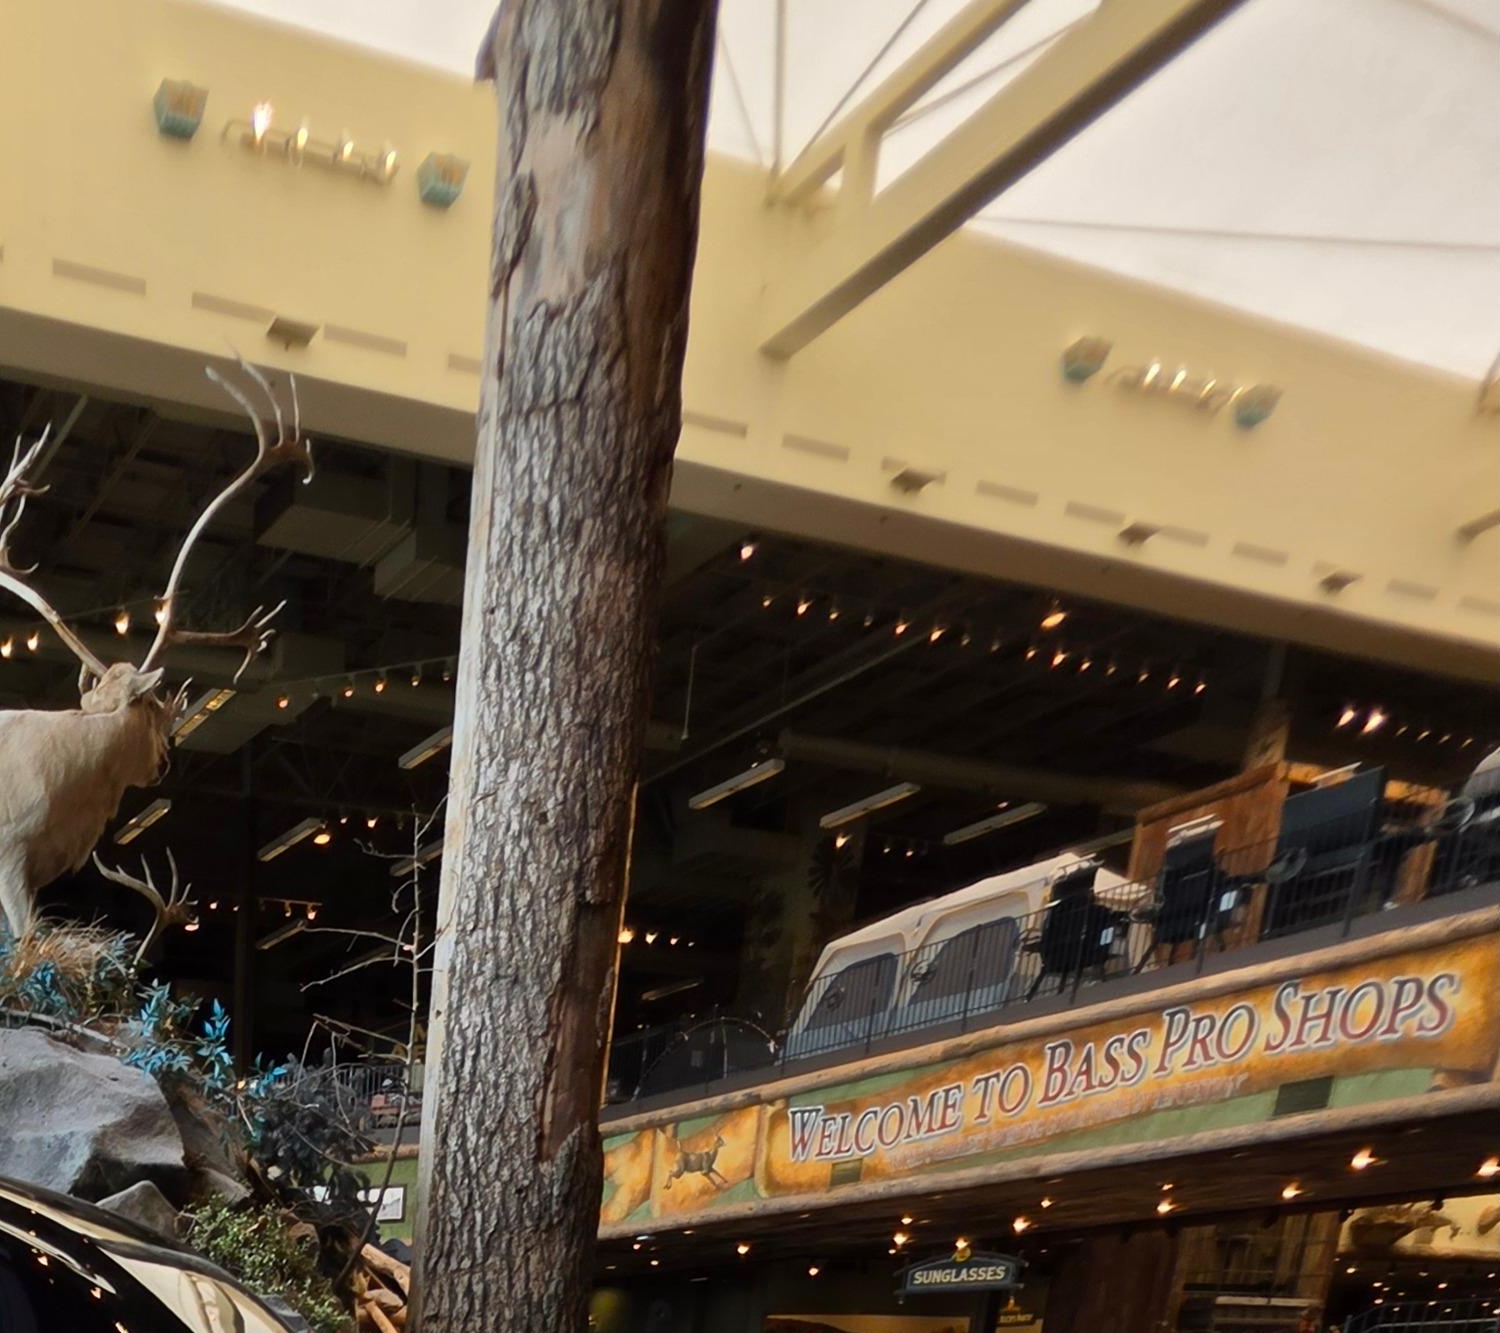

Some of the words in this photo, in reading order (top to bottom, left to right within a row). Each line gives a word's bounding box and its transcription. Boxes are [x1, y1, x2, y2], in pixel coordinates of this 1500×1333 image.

[788, 1083, 965, 1162] WELCOME
[973, 1063, 1030, 1123] TO
[1038, 1029, 1151, 1106] BASS
[1153, 1004, 1258, 1076] PRO
[1263, 973, 1458, 1053] SHOPS
[912, 1265, 1006, 1285] SUNGLASSES
